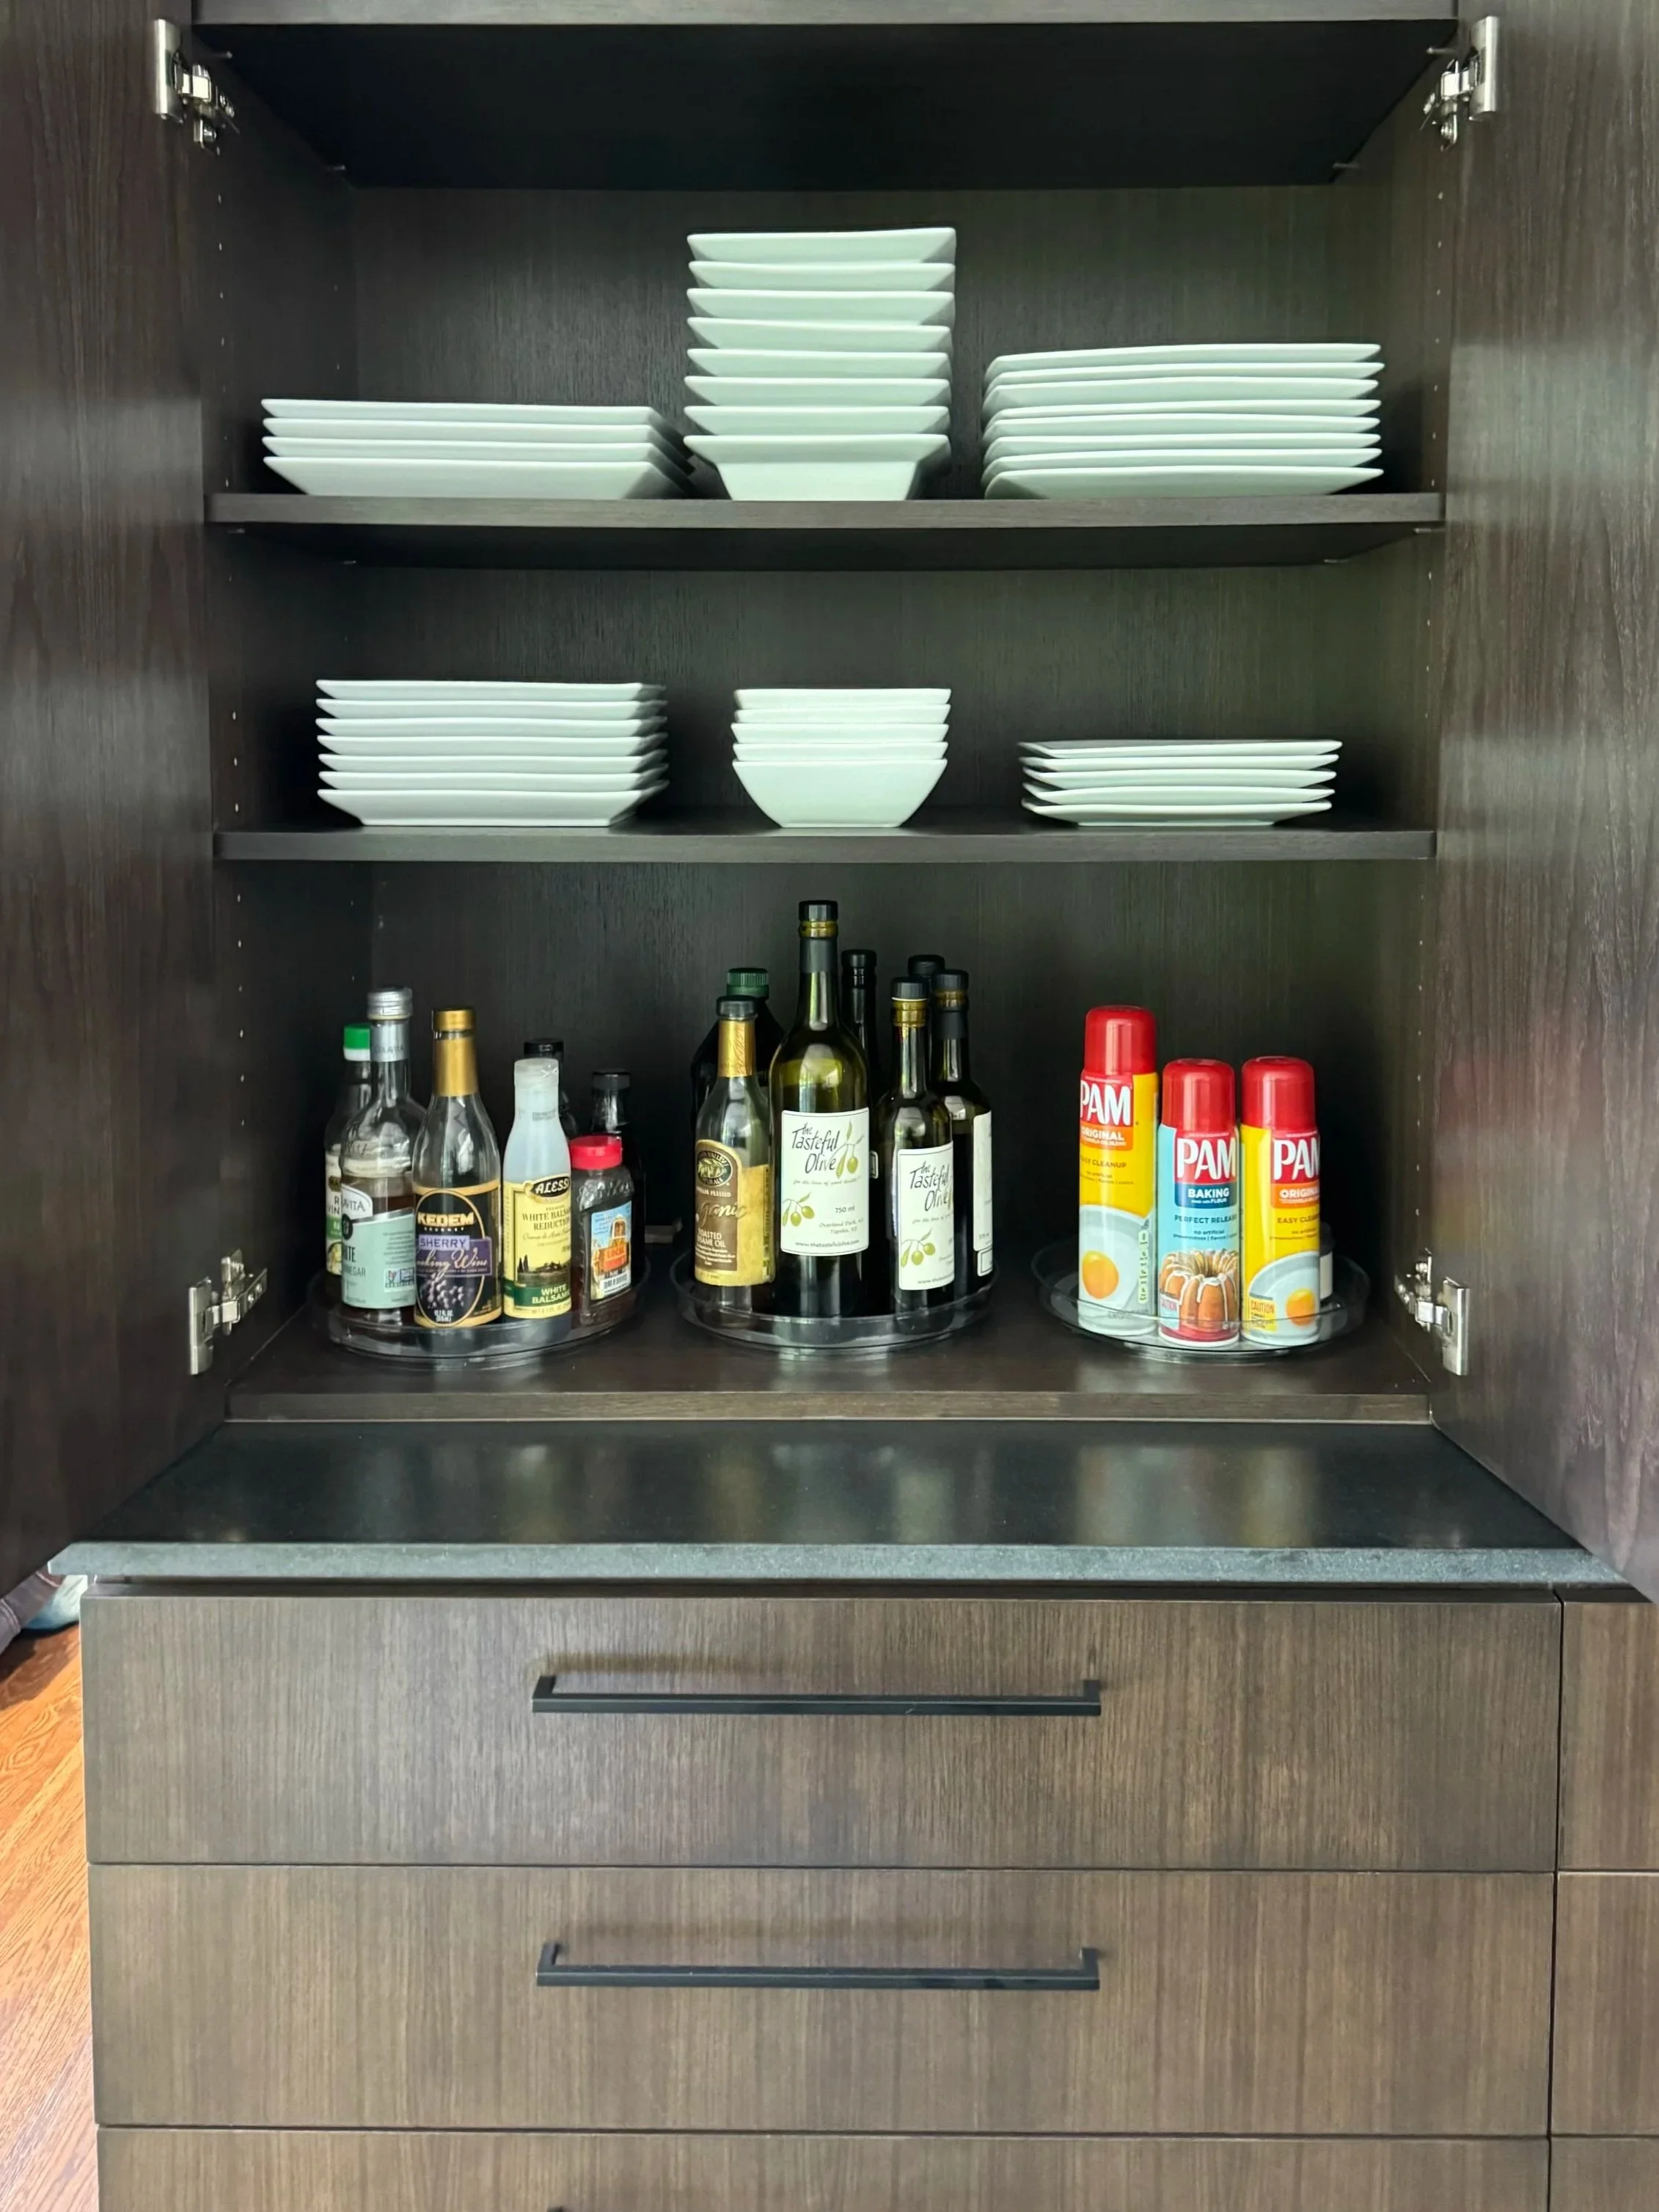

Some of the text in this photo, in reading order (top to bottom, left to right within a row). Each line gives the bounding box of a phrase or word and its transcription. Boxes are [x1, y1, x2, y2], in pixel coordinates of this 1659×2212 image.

[1080, 1080, 1131, 1126] PAM
[1081, 1127, 1125, 1140] ORIGINAL
[791, 1129, 841, 1155] Tasteful
[805, 1153, 837, 1174] Olive
[1092, 1159, 1127, 1168] CLEANUP
[1176, 1138, 1237, 1180] PAM
[535, 1178, 570, 1195] ALESS
[1187, 1188, 1229, 1198] BAKING
[1279, 1188, 1319, 1198] ORIGIN
[417, 1212, 475, 1227] KEDEM
[522, 1212, 549, 1222] WHITE
[1175, 1215, 1209, 1224] PERFECT
[420, 1238, 466, 1248] SHERRY
[714, 1239, 726, 1248] OIL
[451, 1247, 488, 1270] Wine
[541, 1284, 567, 1296] WHITE
[532, 1291, 571, 1304] BALSAM
[1251, 1300, 1275, 1314] CAUTION
